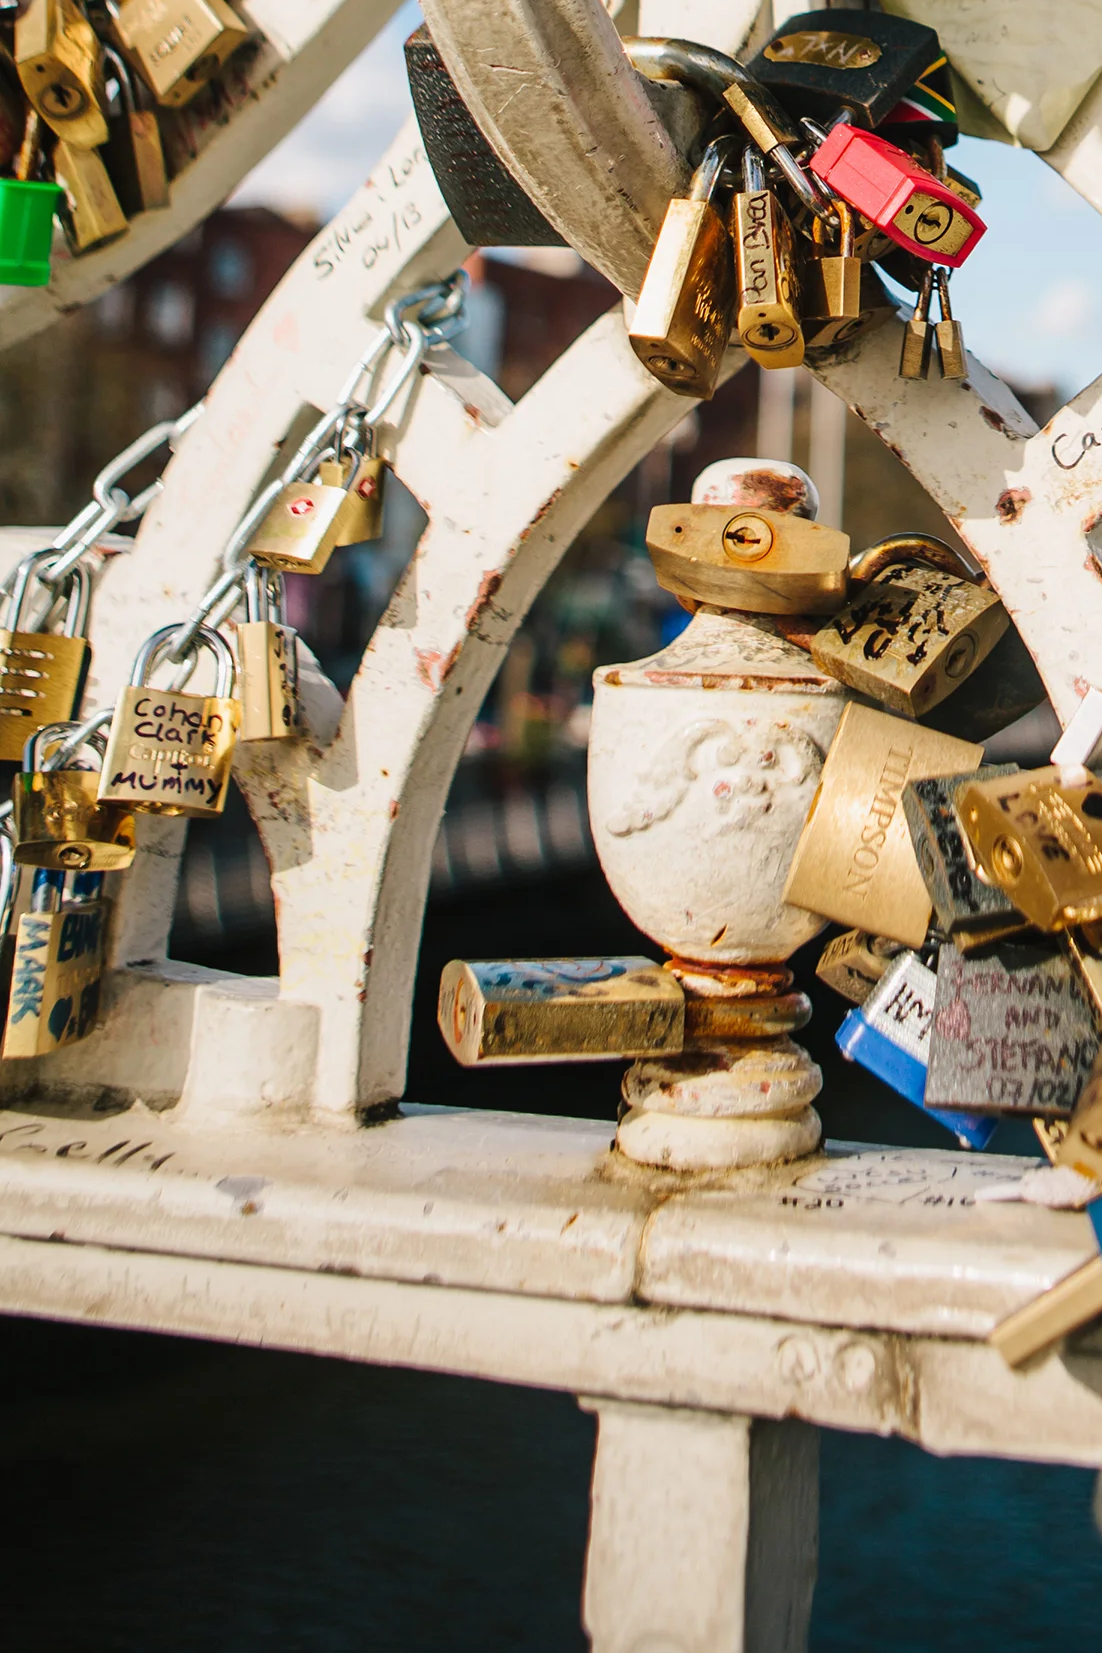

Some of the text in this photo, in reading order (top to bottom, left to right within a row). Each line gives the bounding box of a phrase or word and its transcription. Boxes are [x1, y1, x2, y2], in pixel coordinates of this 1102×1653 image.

[843, 745, 914, 902] TIMPSON
[11, 917, 53, 1026] MARK
[1005, 1004, 1062, 1031] AND
